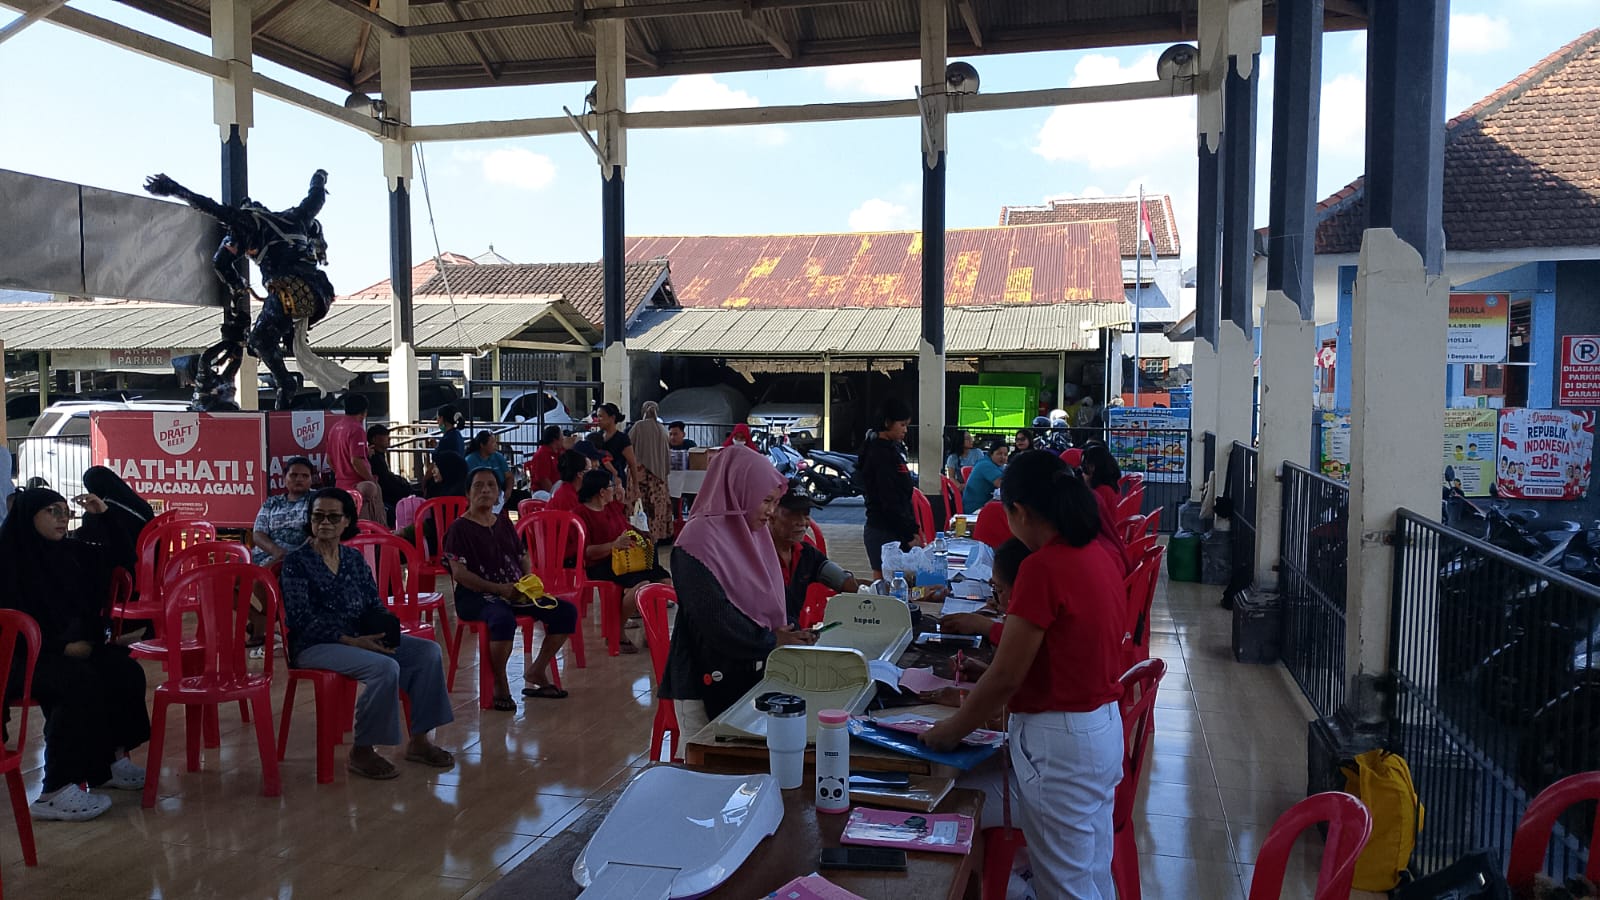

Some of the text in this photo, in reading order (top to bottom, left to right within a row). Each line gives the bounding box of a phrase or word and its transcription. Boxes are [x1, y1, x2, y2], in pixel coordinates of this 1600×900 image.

[118, 356, 163, 366] PARKIR
[159, 424, 193, 442] DRAFT
[296, 421, 321, 438] DRAFT
[1527, 425, 1568, 440] REPUBLIK
[167, 437, 185, 447] BEER
[1524, 439, 1570, 455] INDONESIA
[103, 458, 240, 481] HATI-HATI
[245, 460, 254, 482] !
[135, 482, 200, 494] UPACARA
[203, 483, 255, 495] AGAMA
